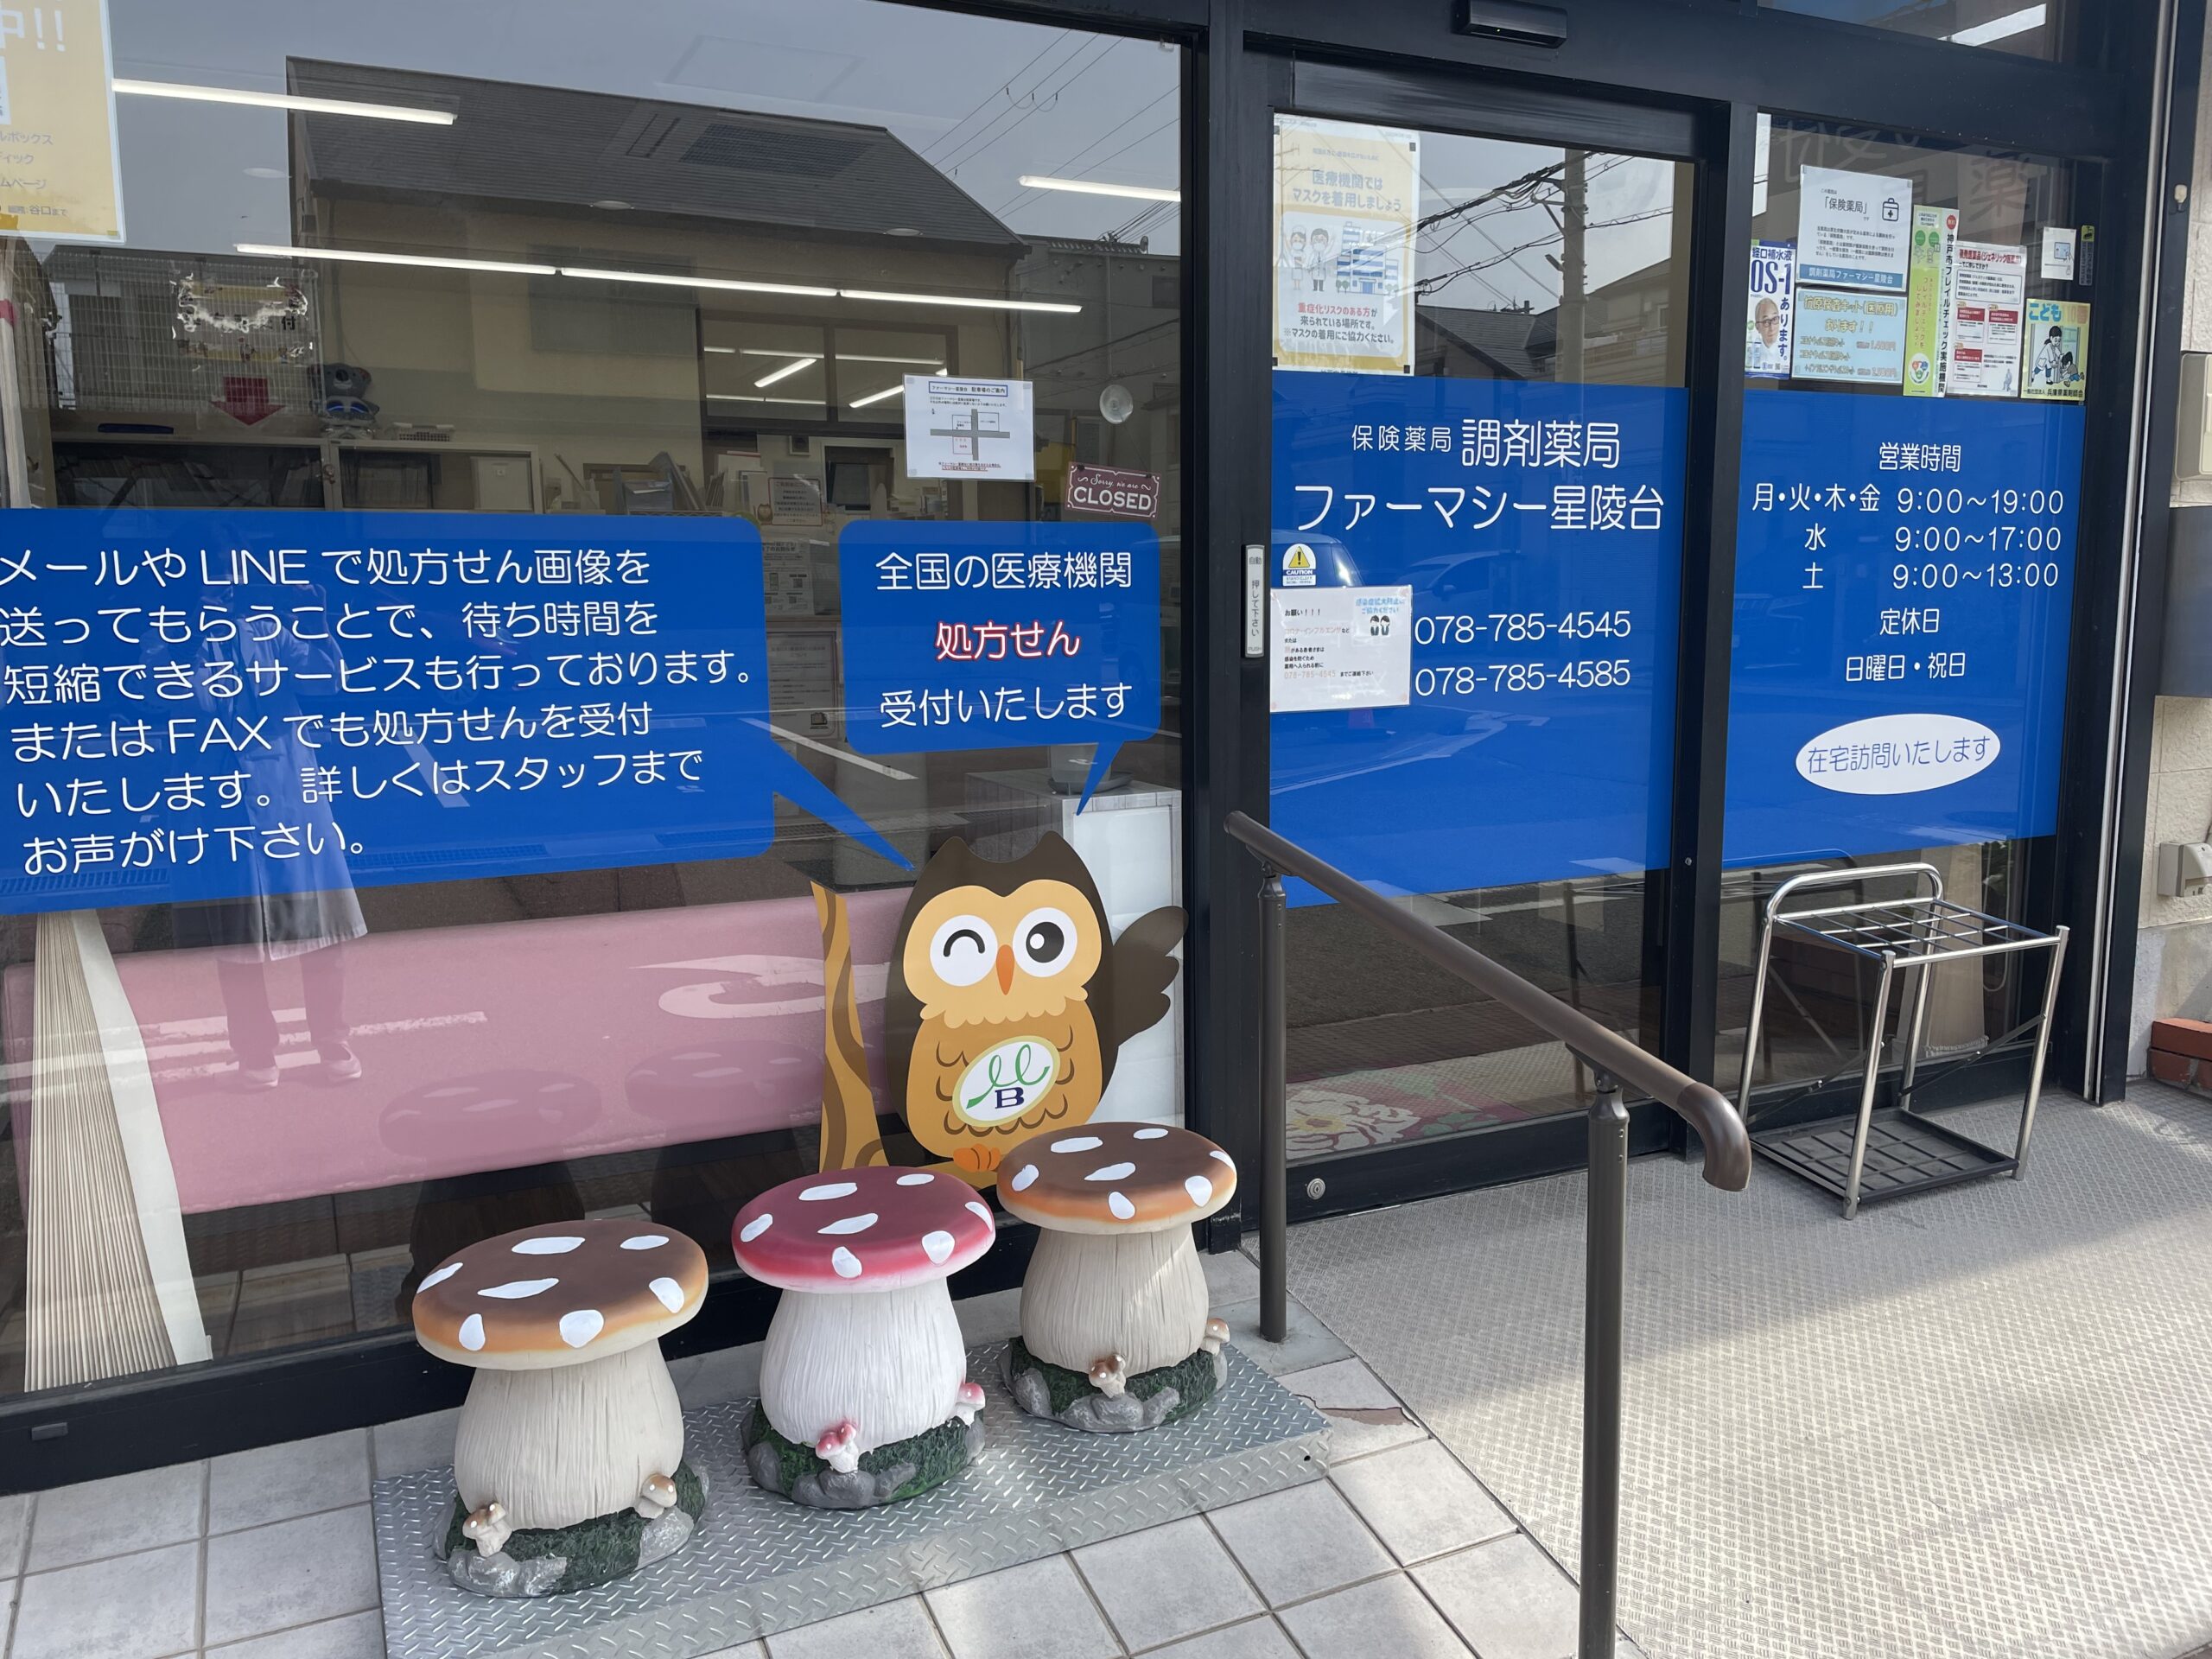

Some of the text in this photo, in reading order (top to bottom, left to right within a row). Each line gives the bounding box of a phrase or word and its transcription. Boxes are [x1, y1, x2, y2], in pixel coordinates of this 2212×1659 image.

[1312, 169, 1383, 191] 医療機関では
[1293, 188, 1402, 212] マスクを着用しましょう
[1824, 195, 1867, 214] 「保険薬局」
[1751, 246, 1793, 261] 経口補水液
[1750, 259, 1792, 295] OS-1
[1808, 267, 1894, 284] 調剤薬局ファーマシー星陵台
[1298, 302, 1378, 318] 重症化リスクのある方が
[1300, 315, 1375, 330] 来られている場所です。
[1938, 233, 1955, 393] 神戸市フレイルチェック実施機関
[1778, 297, 1790, 360] あります。
[1351, 418, 1620, 469] 保険薬局 調剤薬局
[1878, 442, 1962, 473] 営業時間
[1073, 486, 1152, 511] CLOSED
[1294, 483, 1665, 531] ファーマシー星陵台
[1751, 482, 1881, 512] 月・火・木・金
[1803, 522, 1827, 551] 水
[874, 550, 1132, 591] 全国の医療機関
[1249, 556, 1262, 566] 自動
[1802, 562, 1824, 589] 土
[1251, 579, 1260, 637] 押して下さい
[1879, 607, 1941, 636] 定休日
[934, 619, 1082, 662] 処方せん
[1414, 610, 1631, 645] 078-785-4545
[3, 649, 749, 705] 短縮できるサービスも行っております。
[1284, 670, 1336, 680] 078-785-4545
[1414, 658, 1631, 696] 078-785-4585
[1845, 652, 1967, 683] 日曜日・祝日
[880, 681, 1133, 728] 受付いたします
[1807, 735, 1991, 774] 在宅訪問いたします
[22, 821, 364, 875] お声がけ下さい。
[995, 1086, 1025, 1109] B
